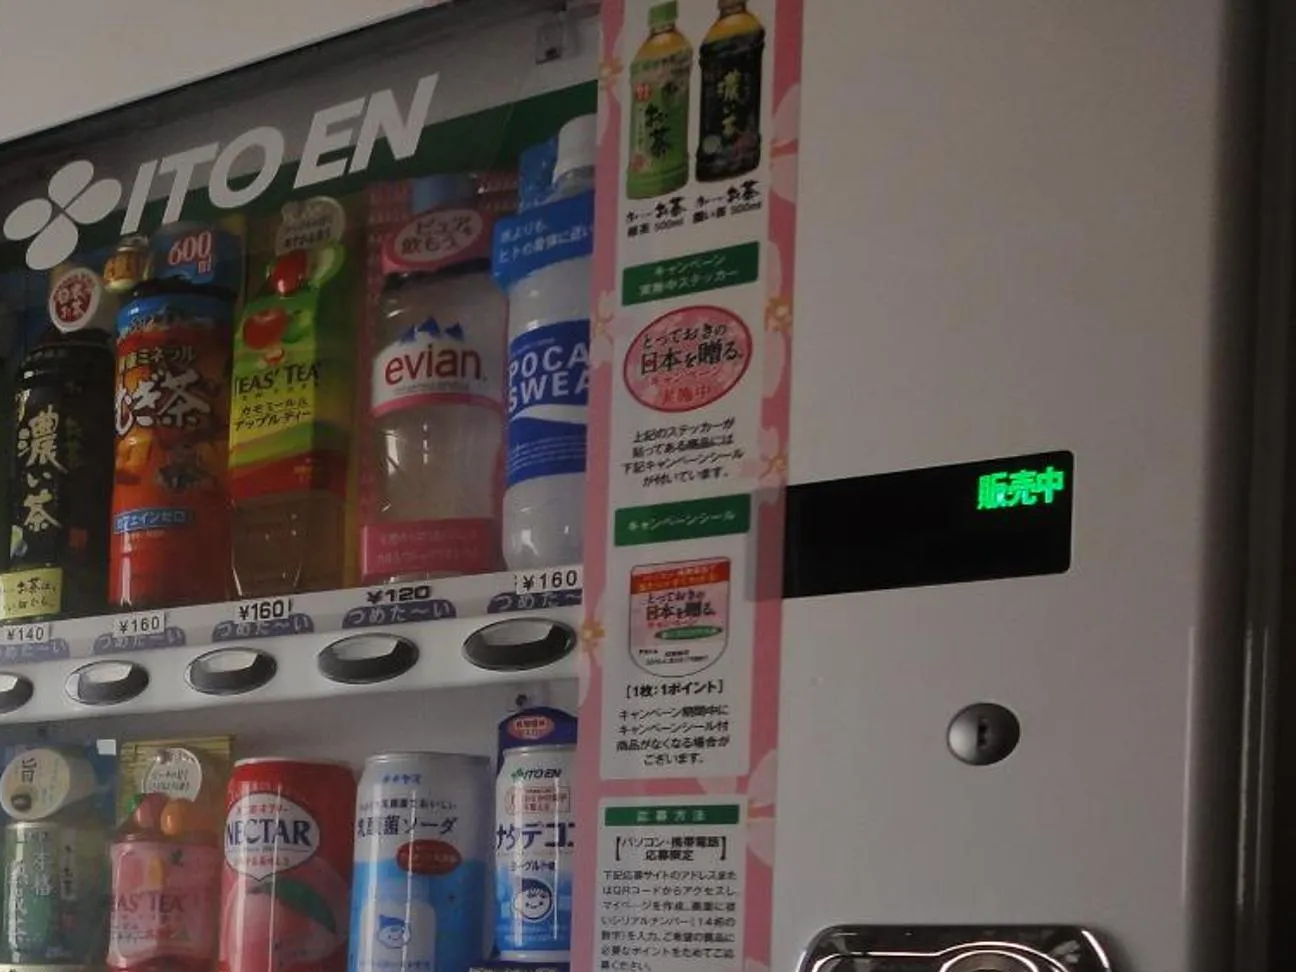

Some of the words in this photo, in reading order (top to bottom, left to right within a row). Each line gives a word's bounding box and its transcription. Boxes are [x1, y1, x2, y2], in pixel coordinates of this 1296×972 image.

[120, 126, 285, 236] ITO
[294, 73, 439, 189] EN
[167, 230, 212, 266] 600
[384, 343, 482, 386] evian
[235, 368, 278, 397] EAS'
[114, 369, 212, 436] むぎ茶
[976, 465, 1065, 511] 販売中
[367, 585, 431, 604] ¥120
[522, 571, 578, 591] ¥160
[119, 616, 161, 634] ¥160
[239, 600, 284, 621] ¥160
[7, 626, 45, 642] ¥140
[227, 818, 312, 847] NECTAR
